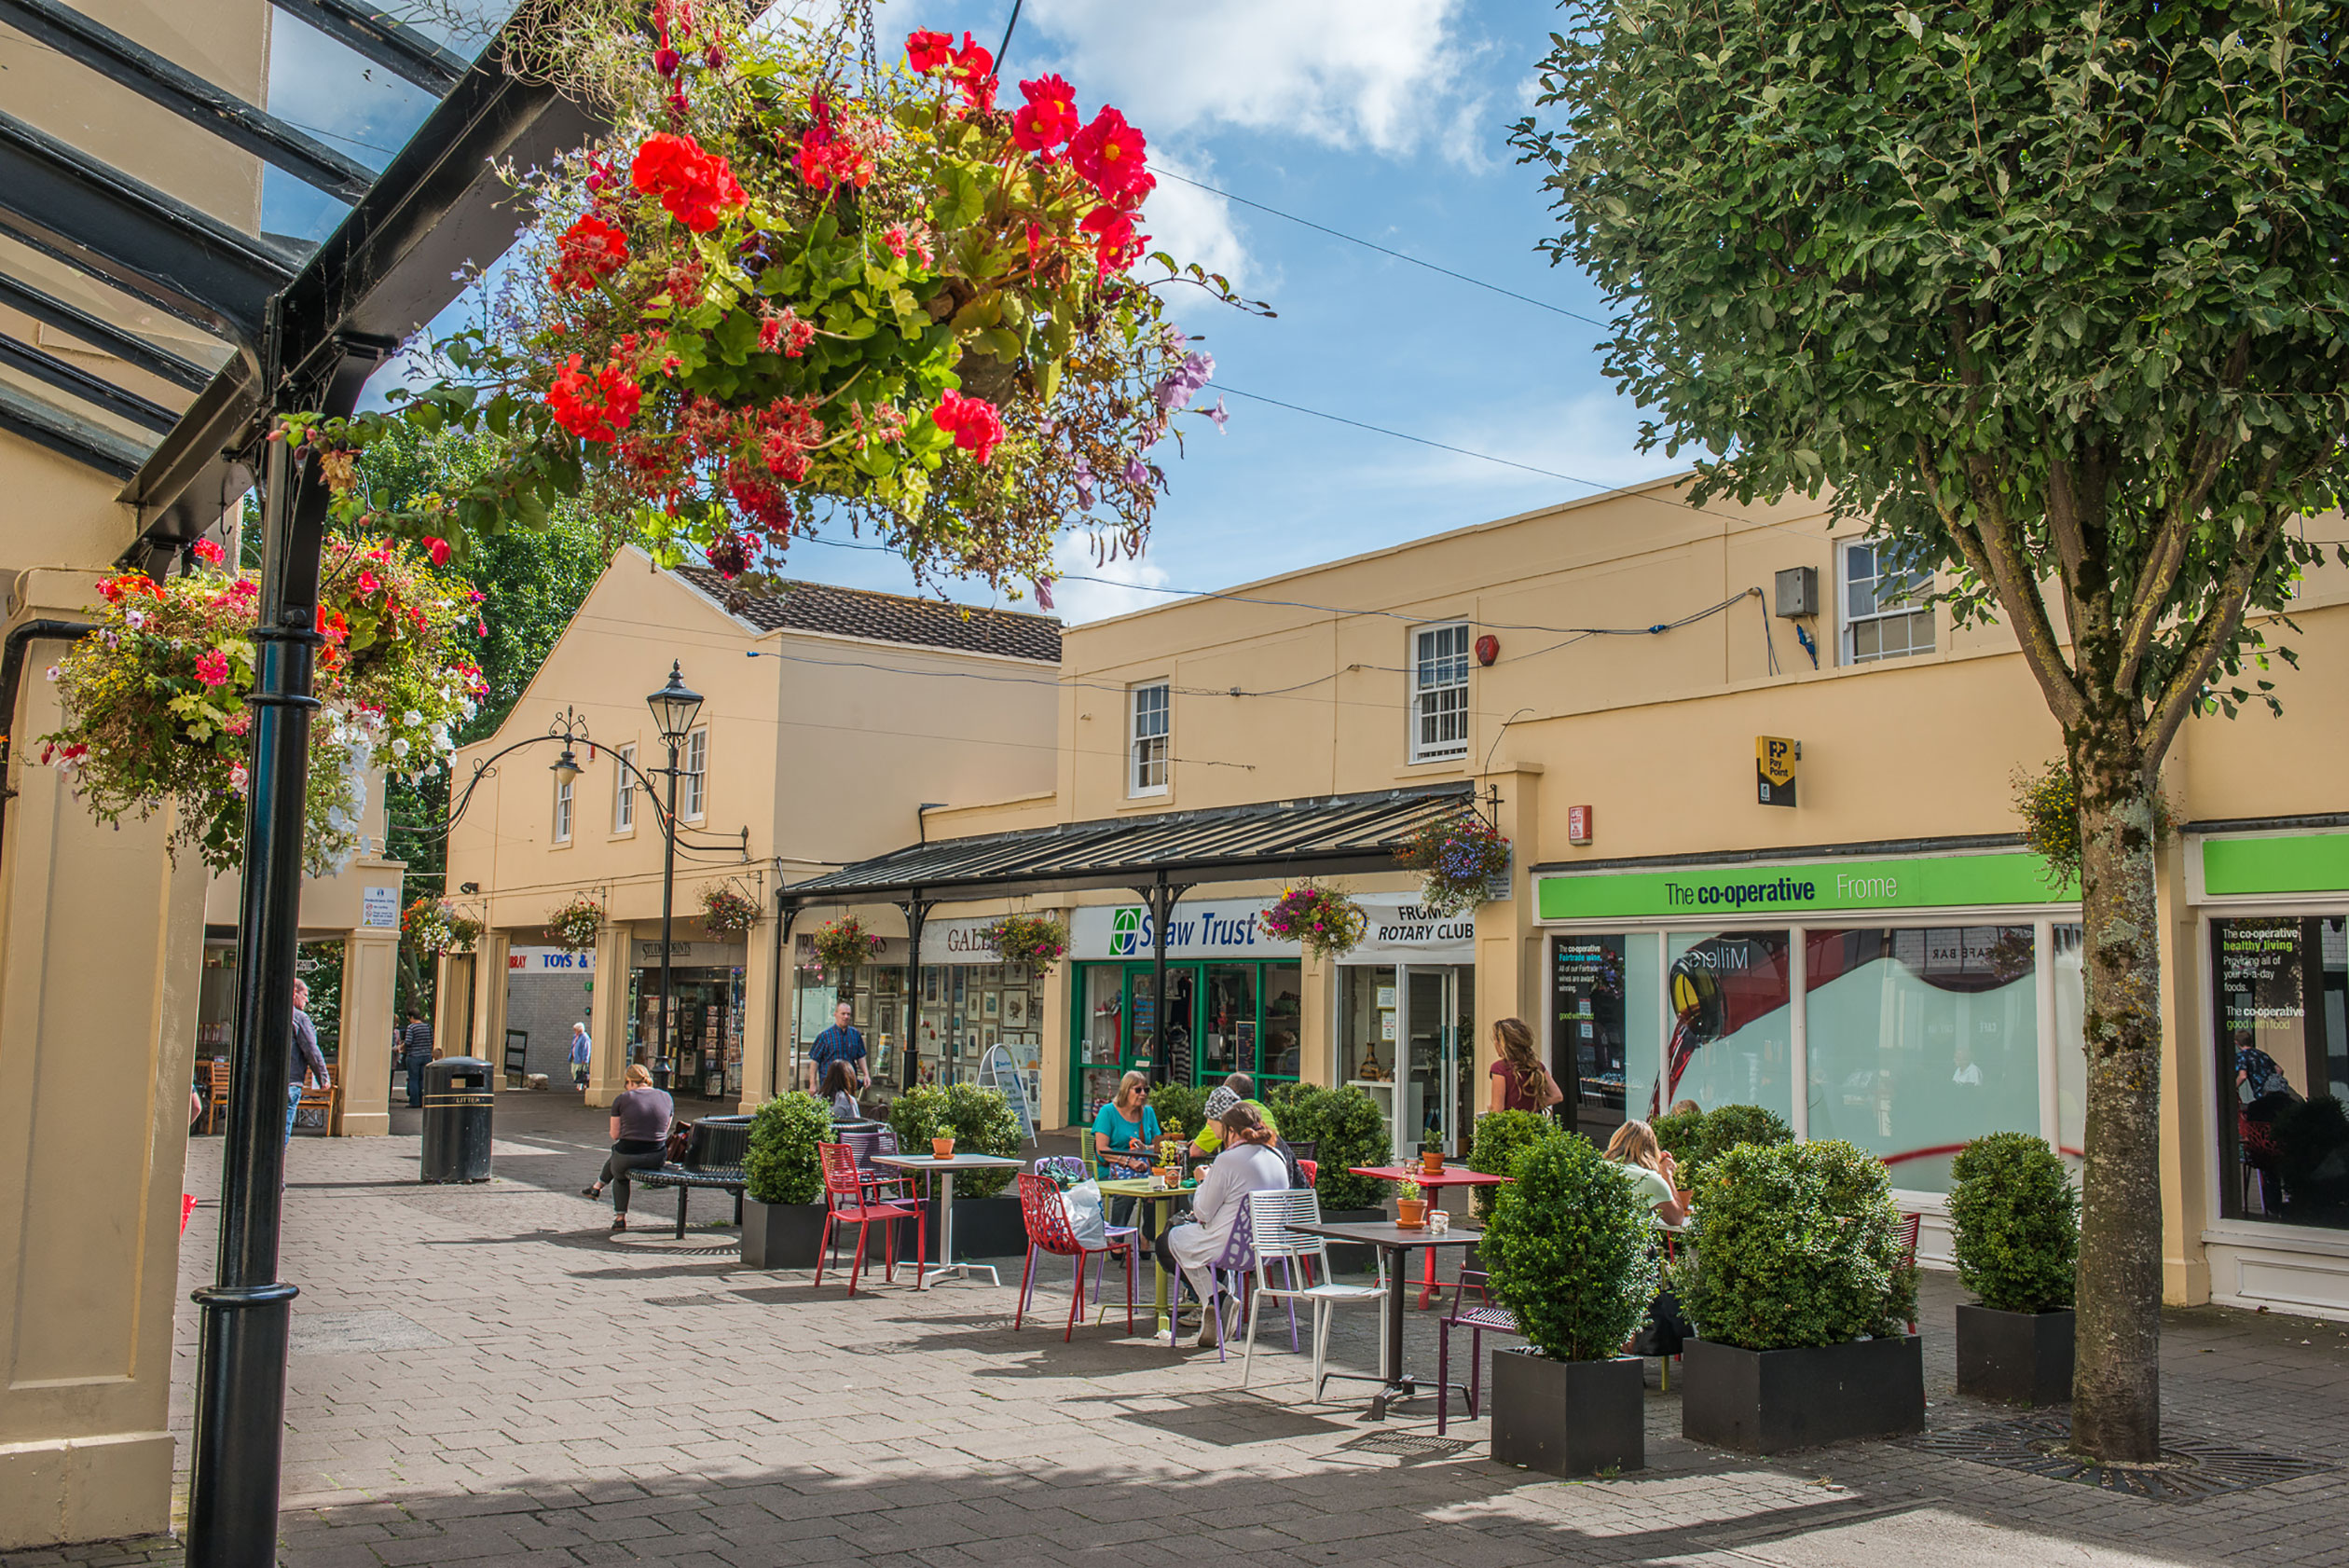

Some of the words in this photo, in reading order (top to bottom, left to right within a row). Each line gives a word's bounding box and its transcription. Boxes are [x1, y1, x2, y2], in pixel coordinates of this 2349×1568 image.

[1769, 758, 1782, 769] Pay
[1769, 767, 1789, 777] Point
[1665, 883, 1695, 905] The
[1697, 877, 1816, 907] co-operative
[1836, 873, 1898, 900] Frome
[1139, 914, 1195, 947] Saw
[1202, 912, 1258, 945] Trust
[1378, 925, 1435, 942] ROTARY
[1437, 923, 1475, 940] CLUB
[2222, 928, 2238, 939] The
[2239, 928, 2299, 941] co-operative
[2223, 940, 2261, 953] healthy
[2263, 940, 2293, 953] living
[542, 954, 573, 969] TOYS
[578, 954, 588, 969] &
[1559, 953, 1585, 961] Fairtrade
[2223, 956, 2260, 968] Providing
[2260, 956, 2272, 965] all
[2273, 956, 2281, 965] of
[2223, 970, 2241, 981] your
[2243, 969, 2275, 981] 5-a-day
[2225, 1006, 2243, 1016] The
[2243, 1006, 2305, 1018] co-operative
[2226, 1019, 2249, 1031] good
[2249, 1019, 2269, 1029] with
[2269, 1019, 2290, 1029] food
